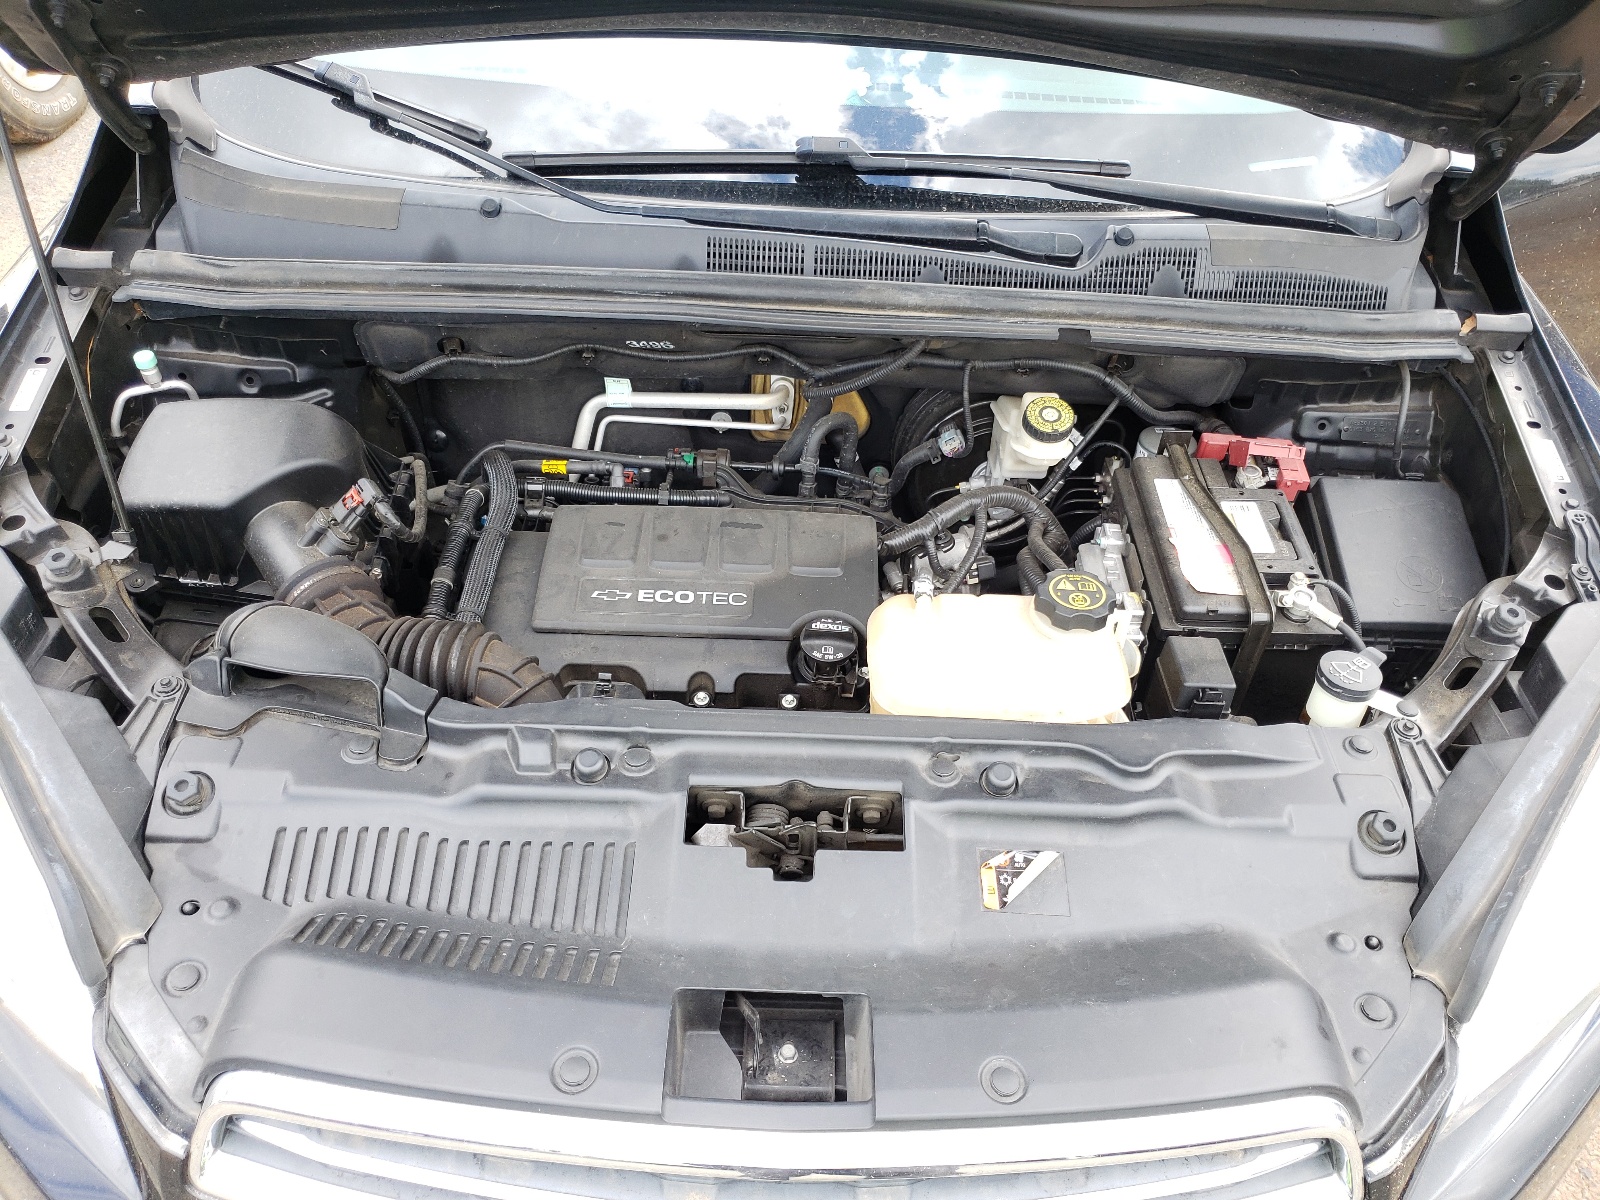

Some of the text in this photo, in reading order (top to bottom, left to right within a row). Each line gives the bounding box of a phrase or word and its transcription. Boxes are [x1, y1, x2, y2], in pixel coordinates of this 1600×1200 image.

[0, 75, 78, 116] TRANSFOR
[638, 589, 747, 606] ECOTEC
[812, 621, 851, 632] dexos
